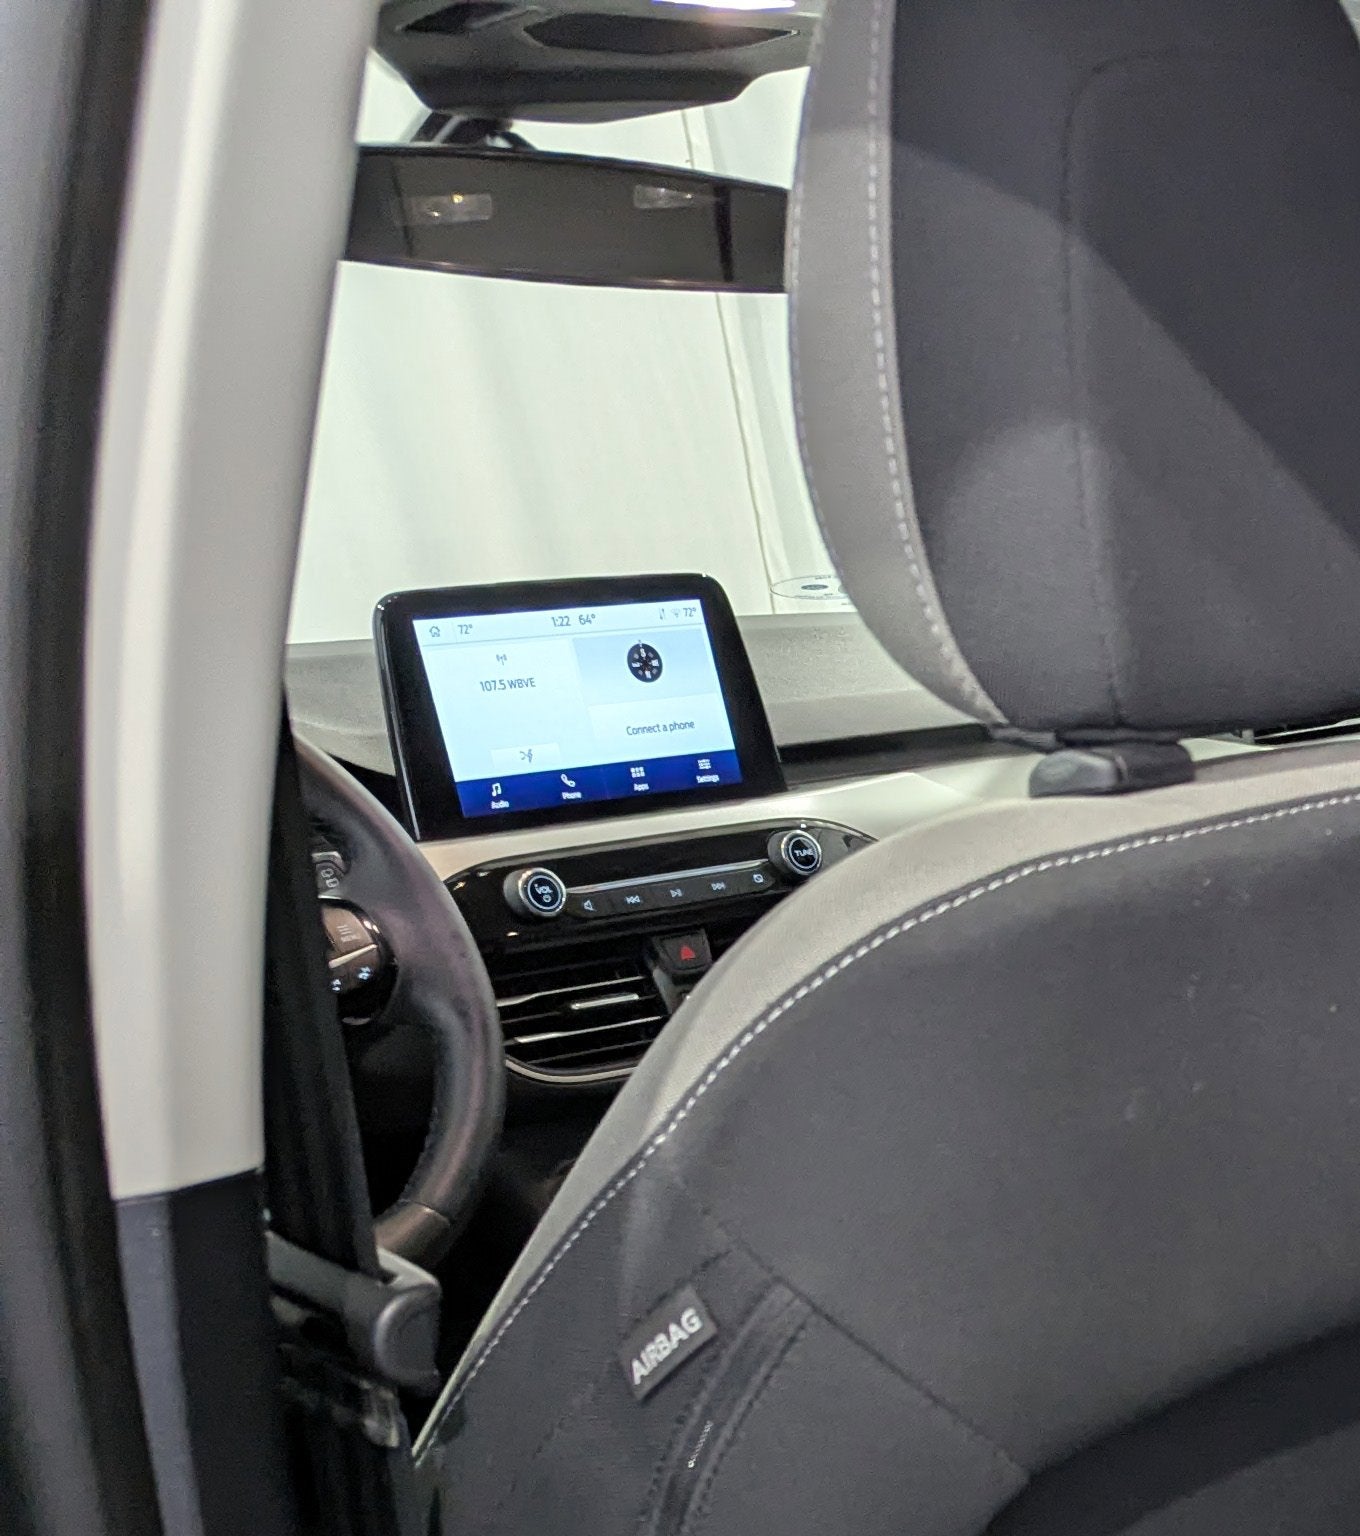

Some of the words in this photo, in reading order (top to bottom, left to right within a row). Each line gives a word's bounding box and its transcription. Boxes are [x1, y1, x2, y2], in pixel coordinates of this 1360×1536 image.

[551, 616, 571, 627] 1:22
[480, 679, 506, 692] 107.5
[626, 723, 661, 736] Connect
[669, 720, 695, 733] phone
[632, 1307, 703, 1385] AIRBAG
